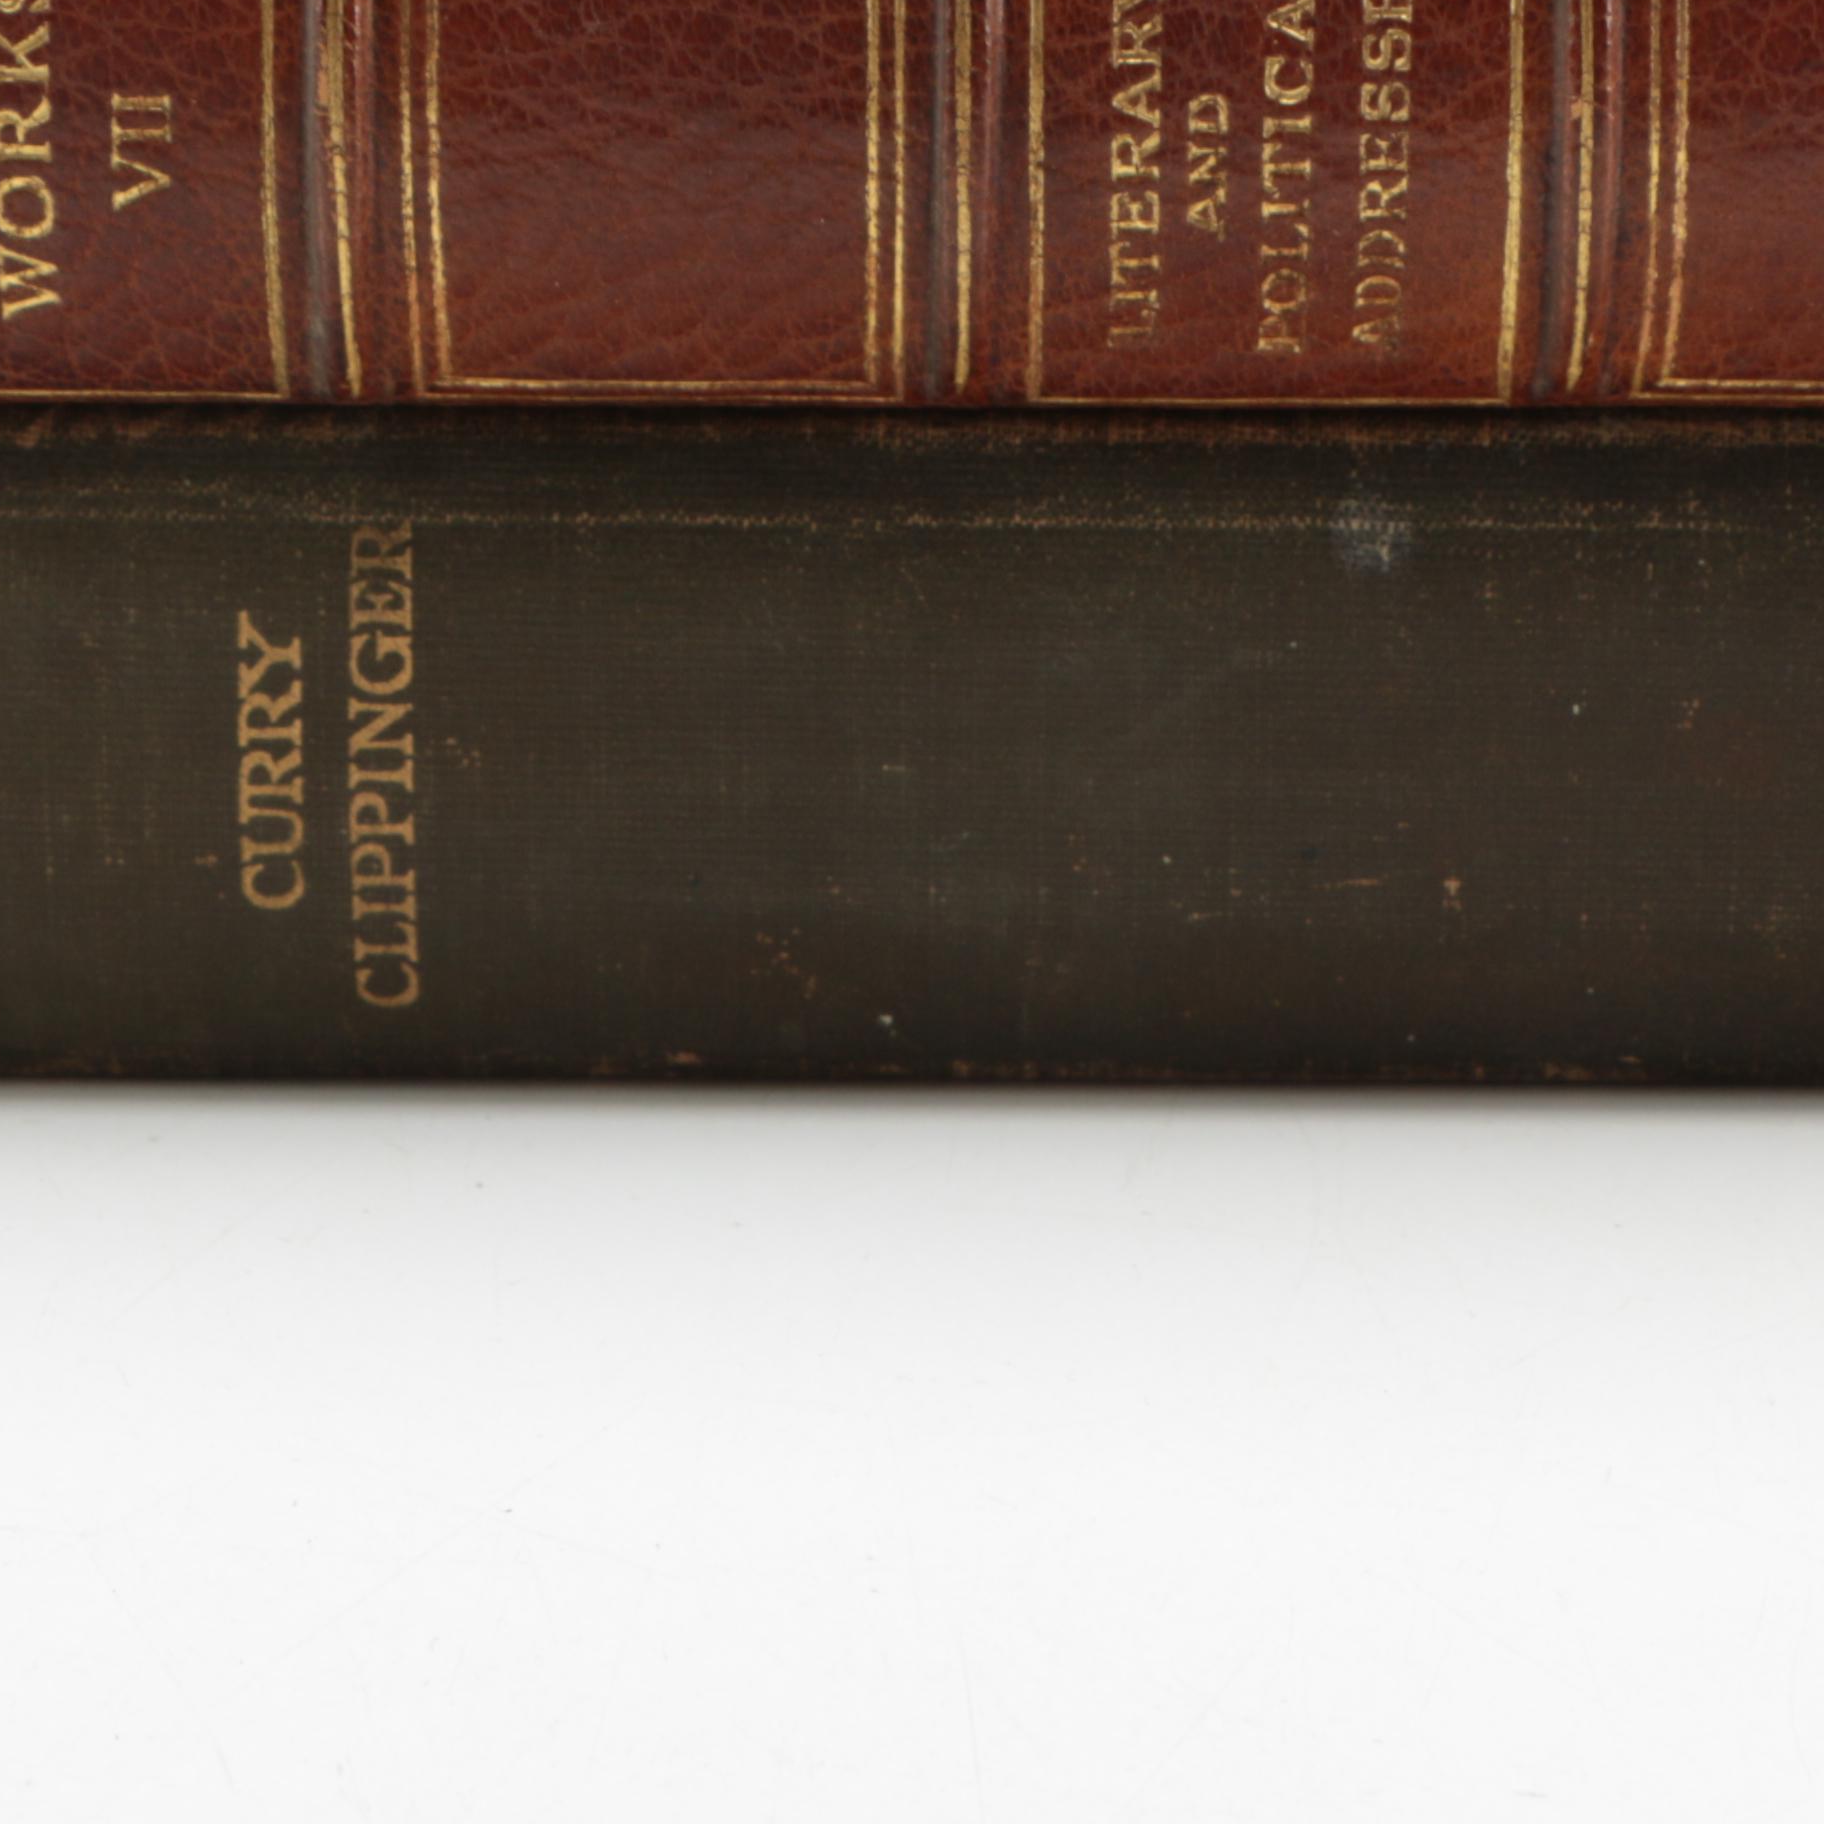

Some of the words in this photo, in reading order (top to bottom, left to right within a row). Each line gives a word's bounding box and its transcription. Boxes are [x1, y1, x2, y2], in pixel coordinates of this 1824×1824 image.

[111, 92, 171, 211] VII
[1187, 94, 1228, 241] AND
[238, 610, 305, 910] CURRY
[348, 521, 421, 1008] CLIPPINGER
